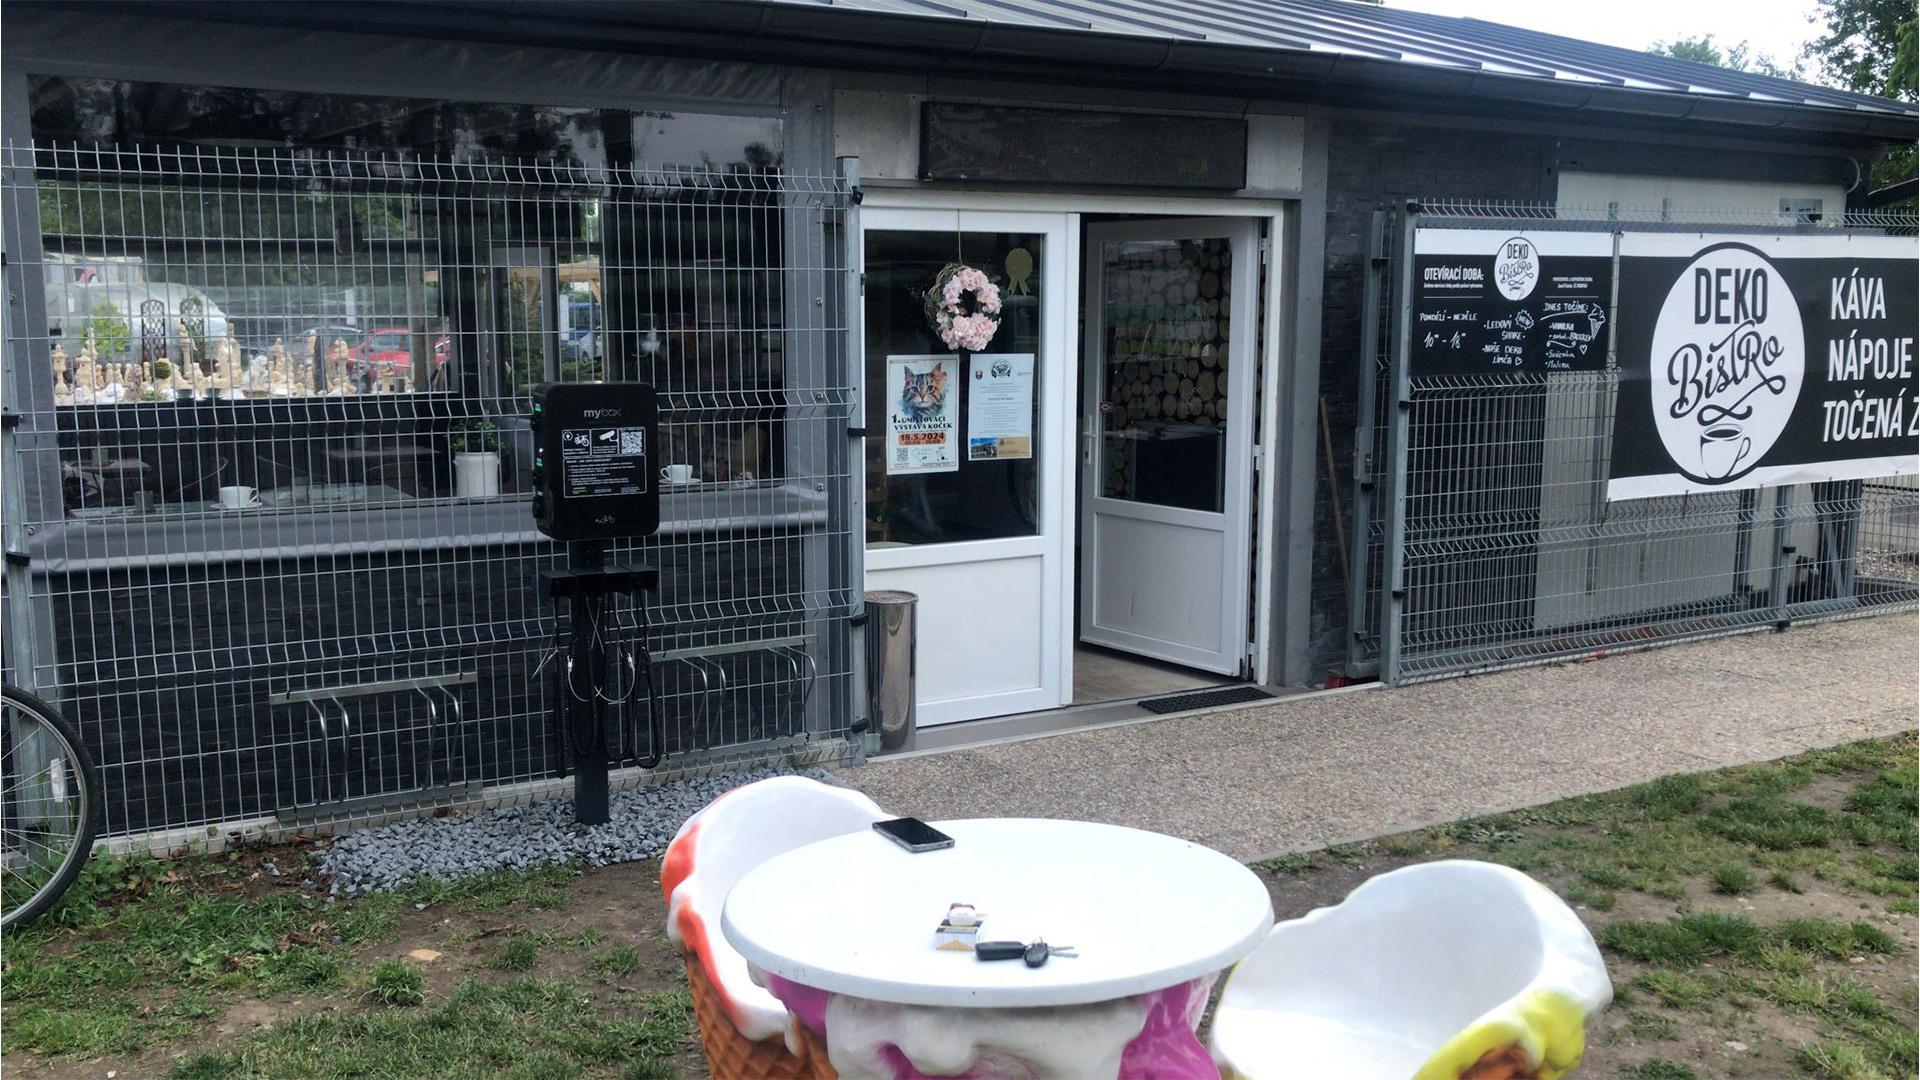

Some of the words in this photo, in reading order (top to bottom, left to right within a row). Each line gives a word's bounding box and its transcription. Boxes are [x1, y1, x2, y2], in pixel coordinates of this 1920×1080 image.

[1424, 264, 1461, 281] OTEVÍRACÍ
[1462, 267, 1484, 281] DOBA:
[1507, 243, 1529, 259] DEKO
[1694, 267, 1769, 325] DEKO
[1830, 267, 1887, 320] KÁVA
[1827, 329, 1914, 382] NÁPOJE
[1822, 387, 1907, 443] TOČENÁ
